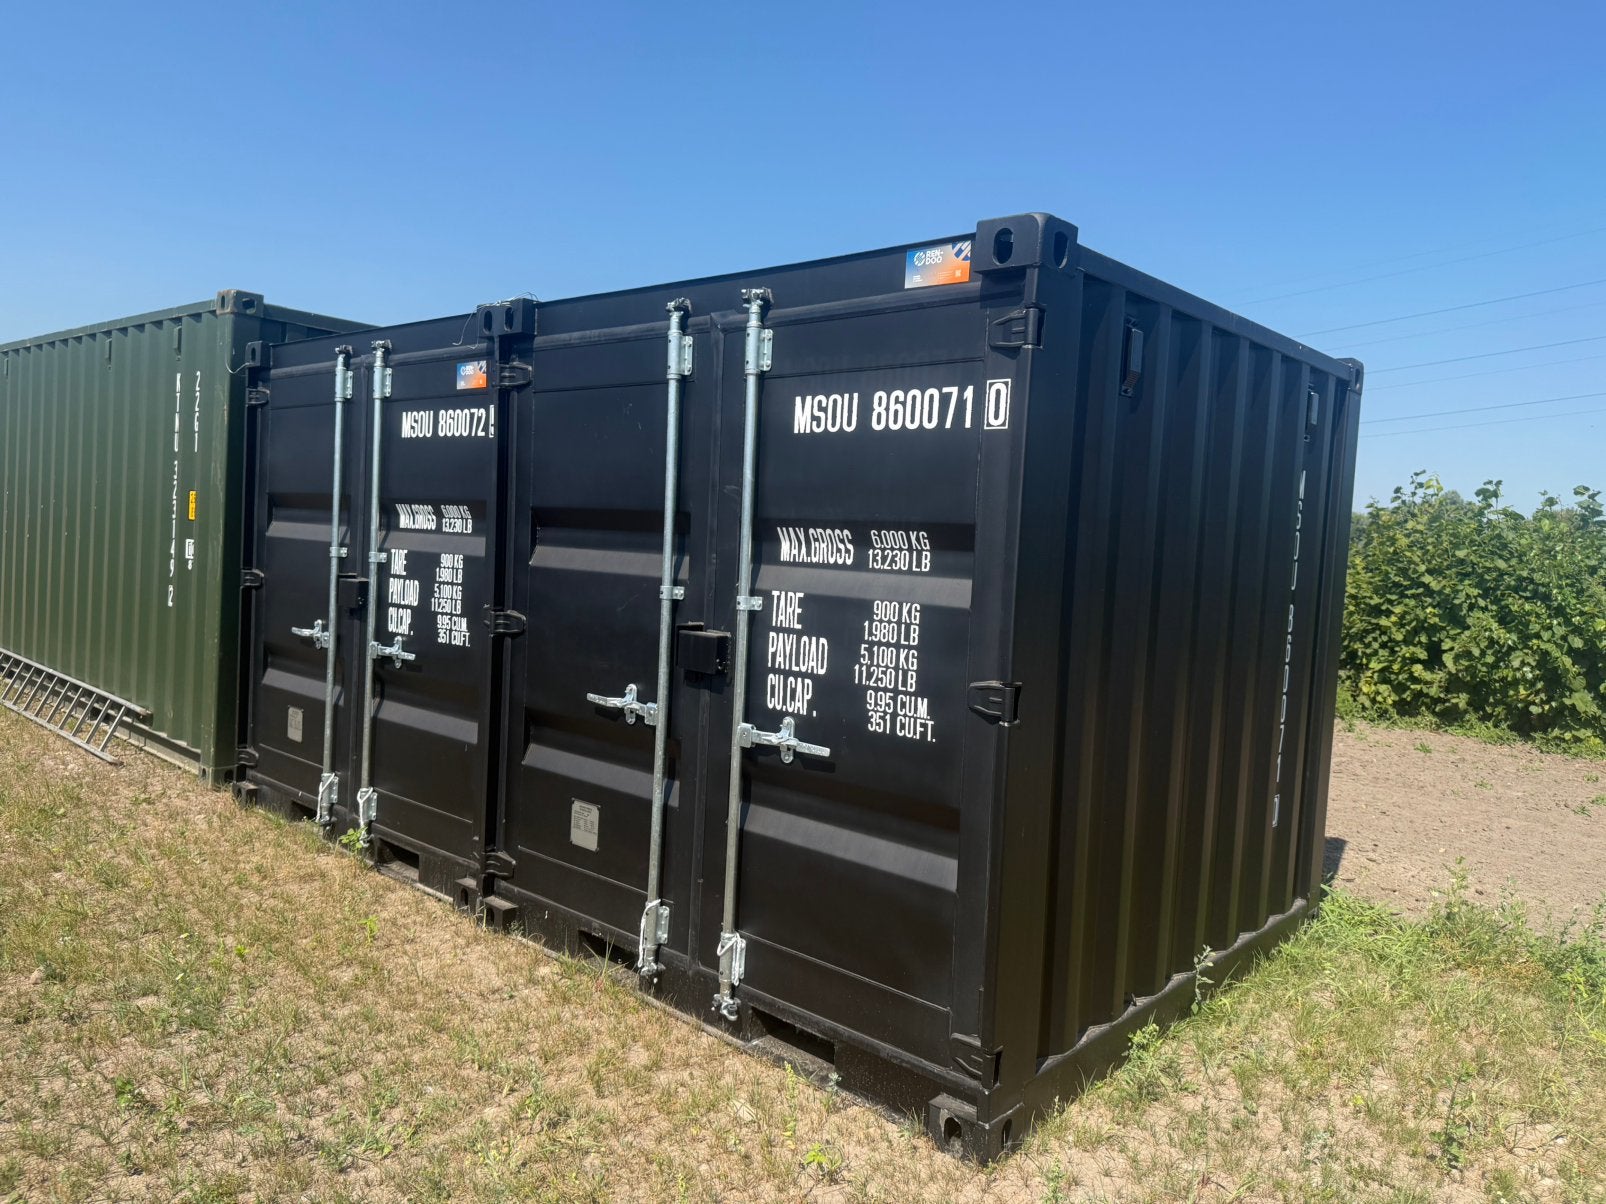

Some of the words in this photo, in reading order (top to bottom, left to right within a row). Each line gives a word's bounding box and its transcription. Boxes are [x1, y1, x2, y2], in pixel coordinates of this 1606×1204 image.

[793, 392, 859, 434] MSOU
[871, 385, 974, 431] 860071
[987, 381, 1008, 428] 0
[401, 410, 434, 438] MSOU
[438, 408, 486, 437] 860072
[459, 505, 472, 518] KG
[463, 519, 473, 534] LB
[777, 527, 854, 565] MAX.GROSS
[870, 530, 908, 549] 6,000
[909, 531, 931, 550] KG
[391, 549, 408, 575] TARE
[441, 554, 454, 568] 900
[454, 554, 464, 568] KG
[868, 549, 909, 570] 13,230
[912, 551, 931, 572] LB
[453, 569, 463, 584] LB
[388, 578, 419, 607] PAYLOAD
[452, 585, 463, 600] KG
[452, 600, 462, 615] LB
[771, 590, 804, 629] TARE
[873, 600, 899, 622] 900
[902, 602, 921, 624] KG
[438, 629, 450, 643] 351
[900, 624, 919, 645] LB
[768, 632, 828, 675] PAYLOAD
[860, 643, 896, 667] 5,100
[899, 648, 917, 670] KG
[854, 663, 895, 689] 11,250
[898, 670, 917, 692] LB
[866, 690, 894, 713] 9.95
[897, 694, 930, 719] CU.M.
[1277, 604, 1295, 783] 860071
[867, 711, 891, 734] 351
[896, 716, 936, 742] CU.FT.
